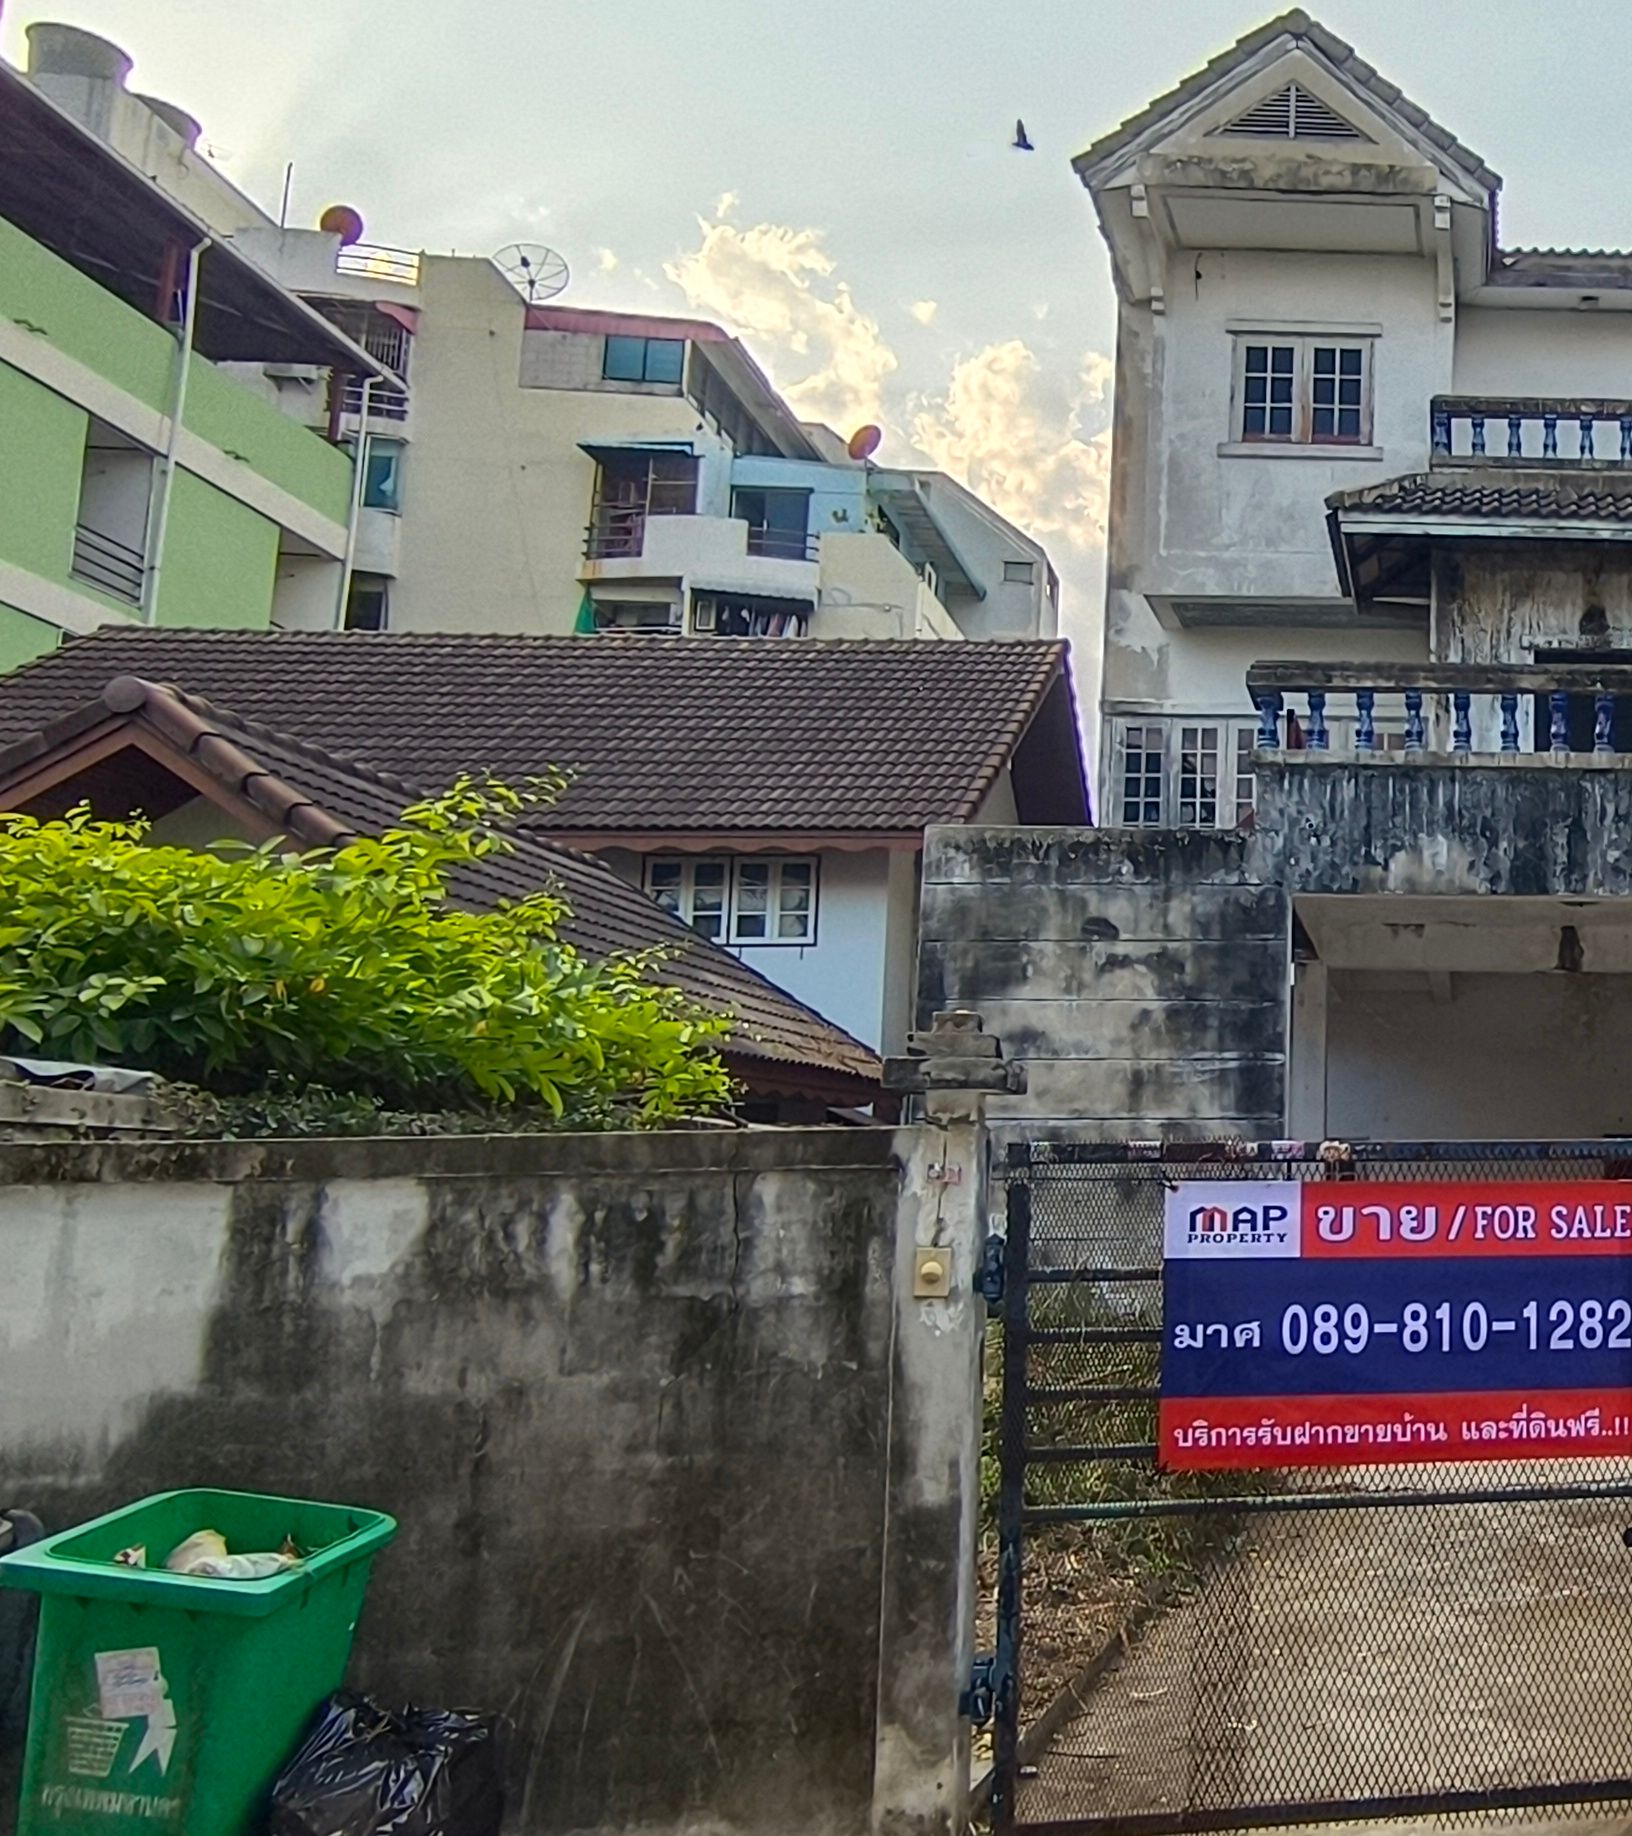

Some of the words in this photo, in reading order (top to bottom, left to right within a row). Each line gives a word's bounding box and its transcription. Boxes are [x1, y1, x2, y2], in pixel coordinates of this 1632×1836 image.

[1189, 1206, 1288, 1232] MAP
[1317, 1205, 1436, 1242] ขาย
[1550, 1204, 1632, 1239] SALE
[1187, 1232, 1288, 1244] PROPERTY
[1173, 1320, 1262, 1349] มาศ
[1281, 1300, 1632, 1355] 089-810-1282
[1173, 1411, 1448, 1447] บริการรับฝากขายบ้าน
